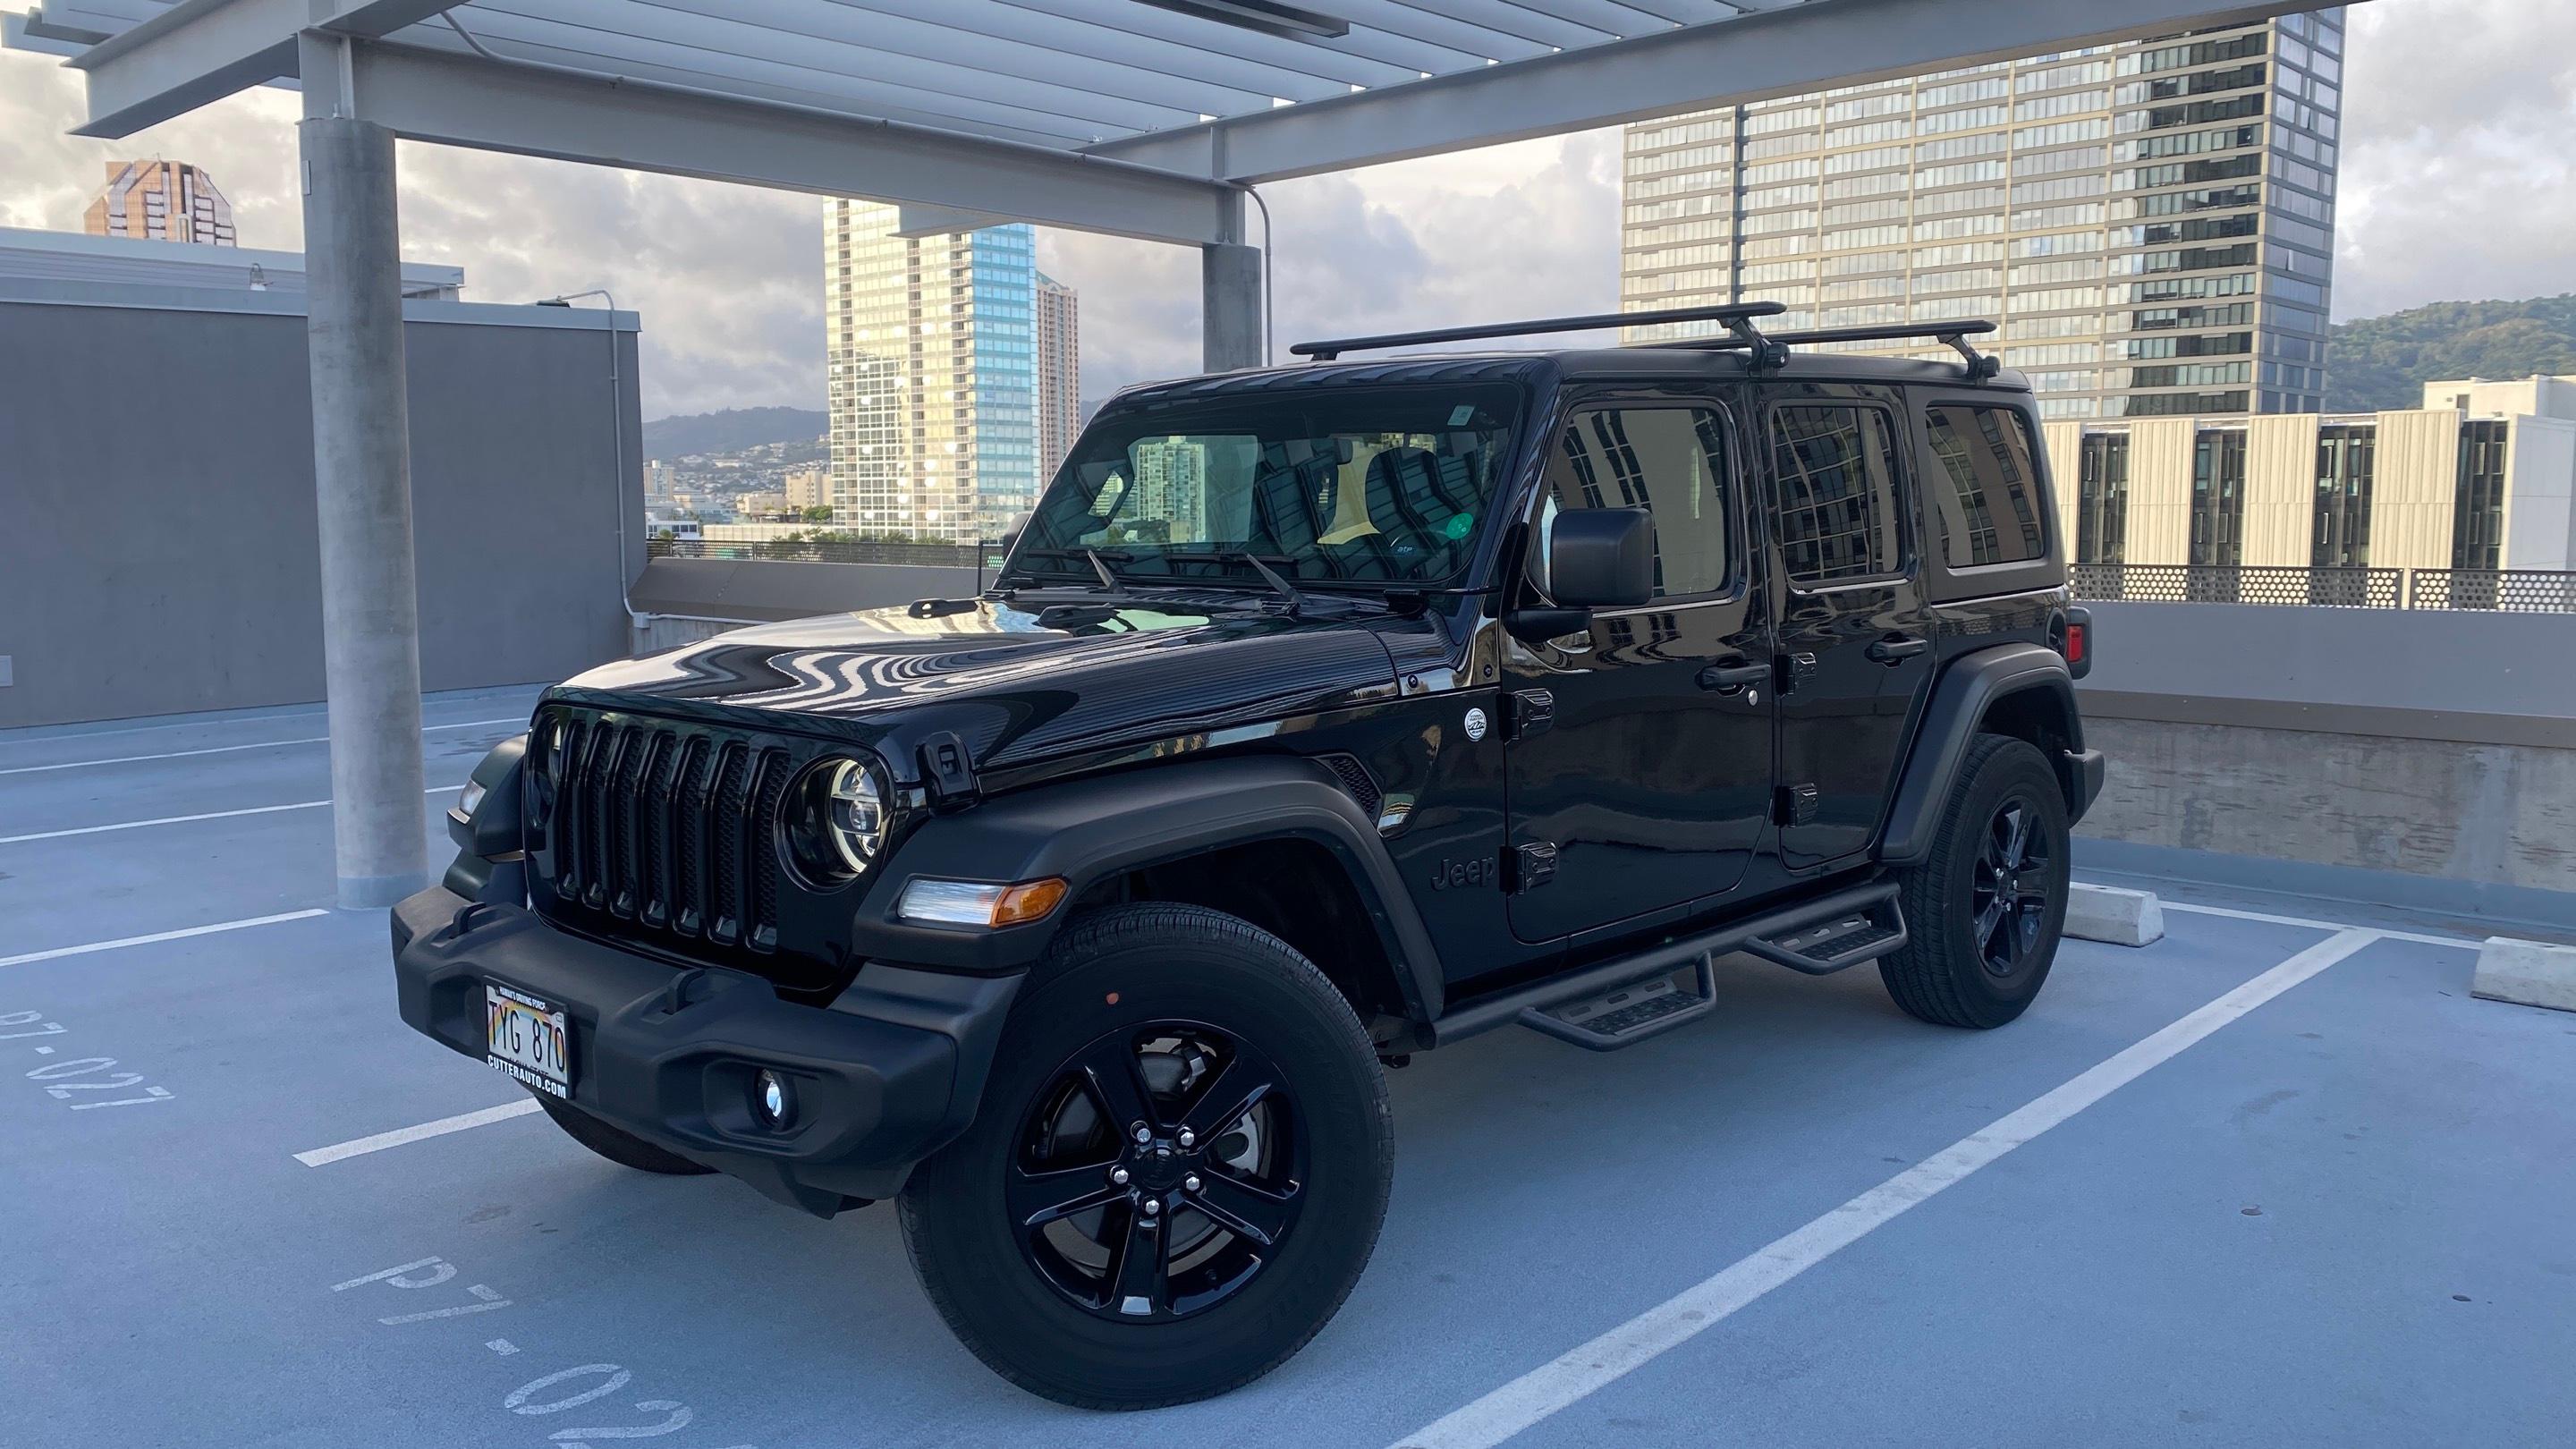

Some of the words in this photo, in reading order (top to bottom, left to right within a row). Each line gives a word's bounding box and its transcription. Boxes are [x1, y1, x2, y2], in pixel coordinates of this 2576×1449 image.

[1431, 856, 1496, 891] Jeep
[488, 1000, 521, 1054] TYG
[532, 1018, 565, 1072] 870
[487, 1055, 566, 1099] CUTTERAUTO.COM
[331, 1255, 753, 1449] P7-02
